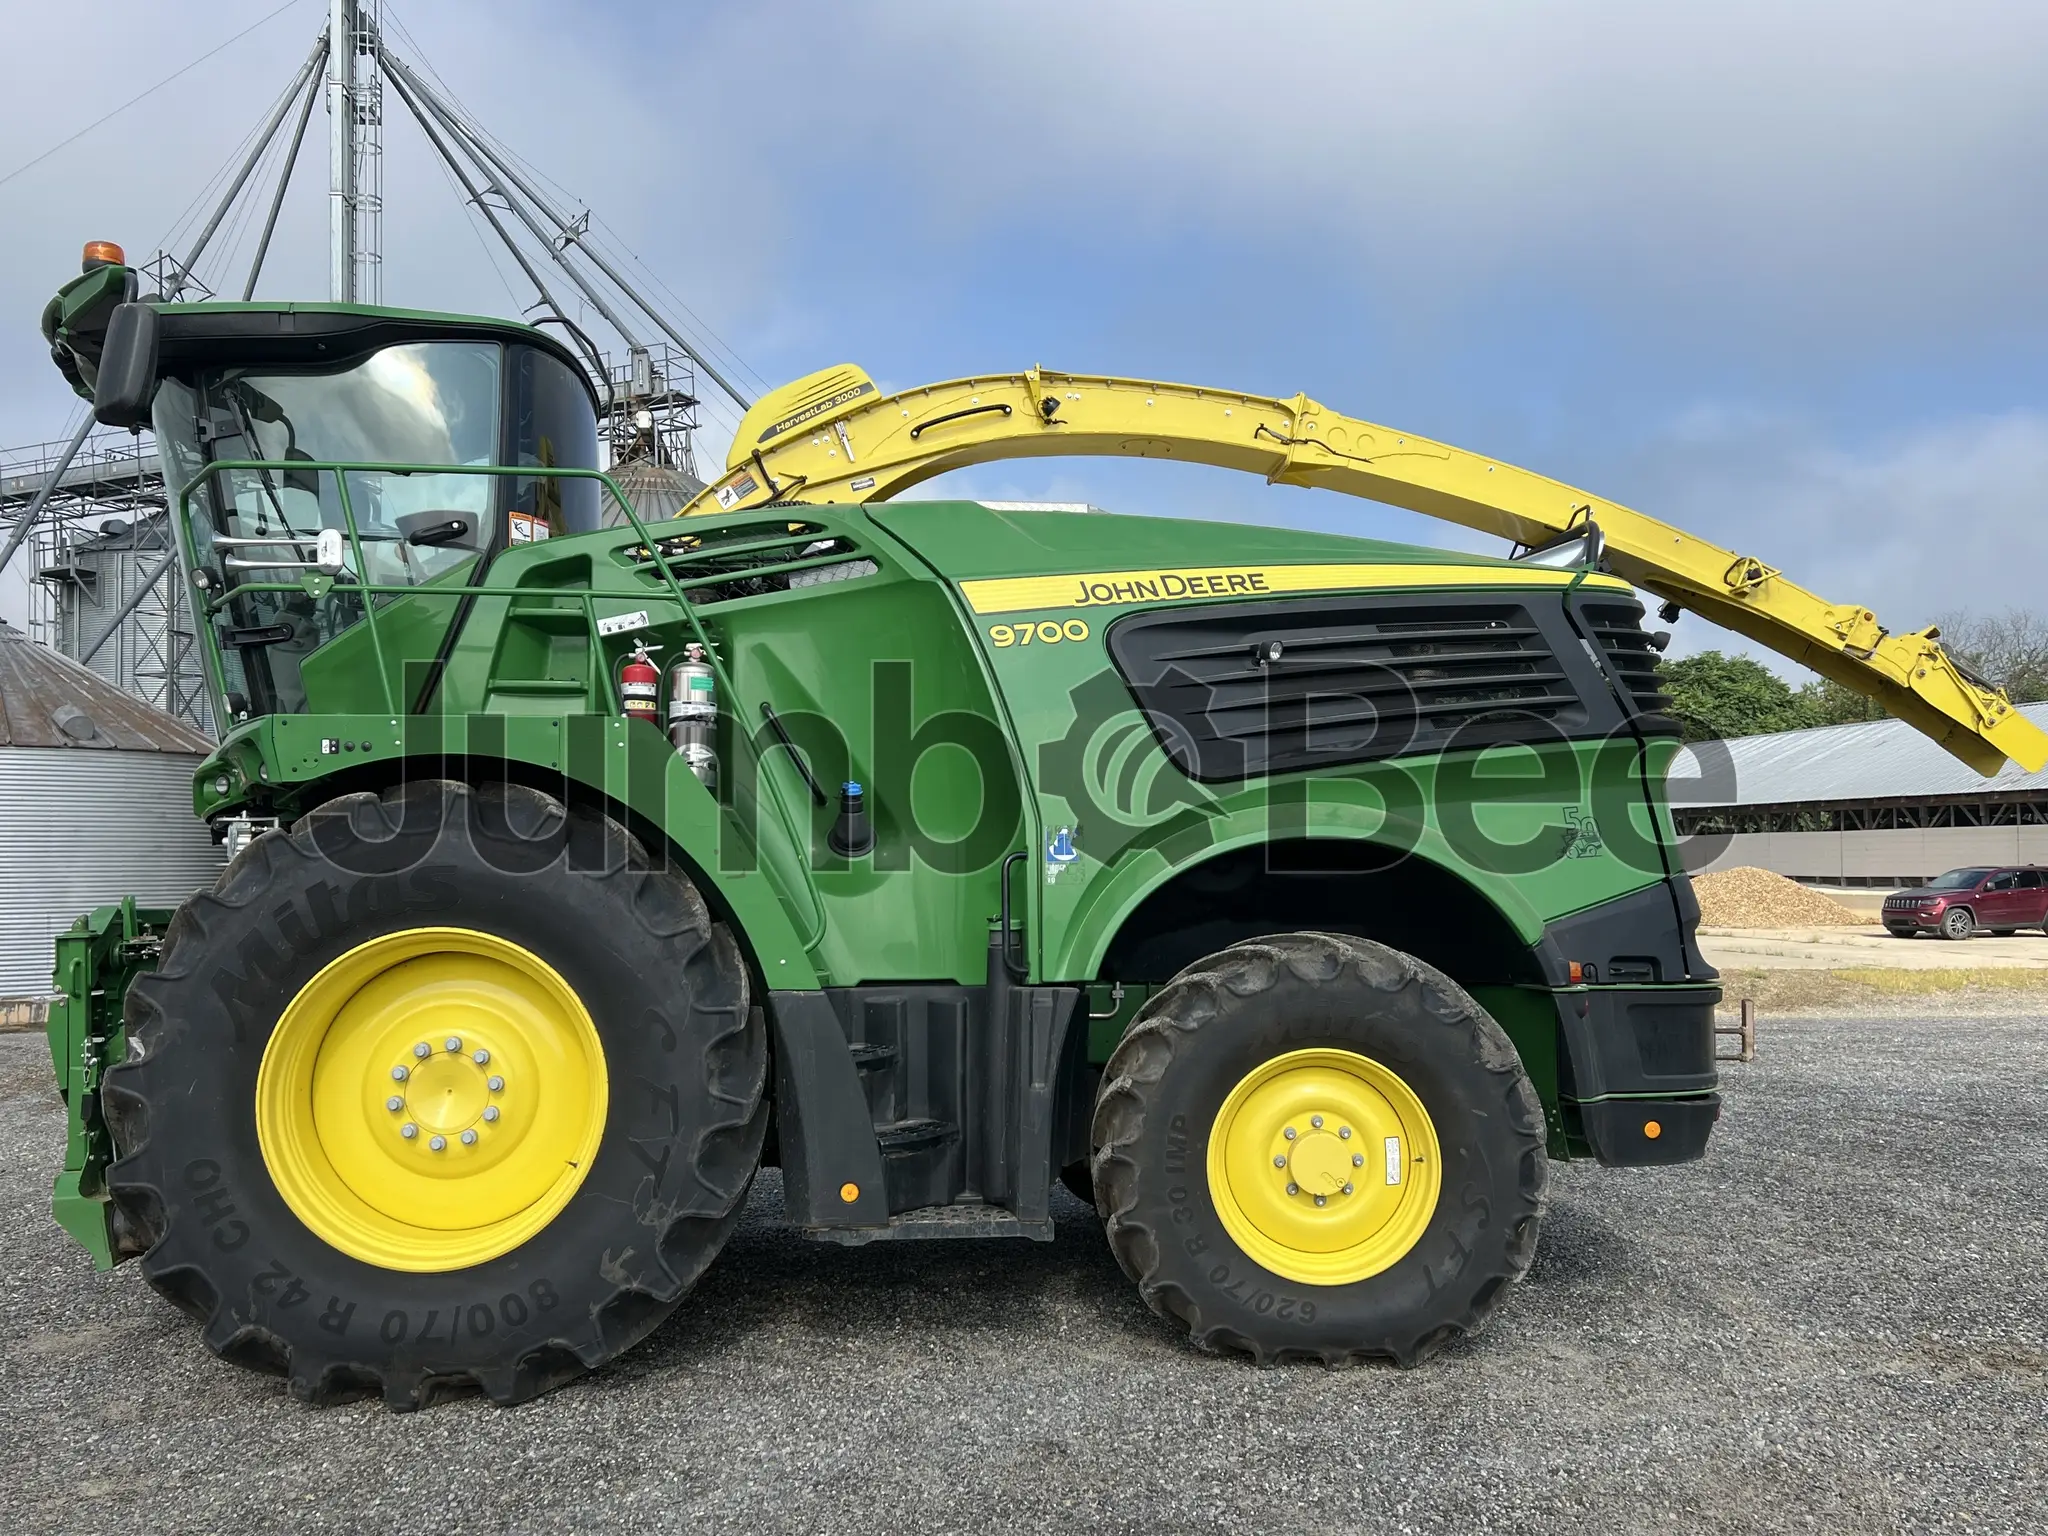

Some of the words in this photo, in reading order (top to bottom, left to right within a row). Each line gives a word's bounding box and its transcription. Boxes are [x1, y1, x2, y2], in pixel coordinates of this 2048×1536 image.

[775, 400, 833, 433] HarvestLab
[834, 387, 861, 405] 3000
[1074, 579, 1159, 604] JOHN
[1159, 573, 1270, 597] DEERE
[988, 618, 1090, 648] 9700
[209, 865, 465, 1045] Mitas
[1164, 1114, 1191, 1174] IMP
[1167, 1185, 1194, 1226] 30
[251, 1258, 312, 1309] 42
[1207, 1264, 1317, 1325] 620/70
[317, 1293, 358, 1337] R
[379, 1276, 562, 1347] 800/70
